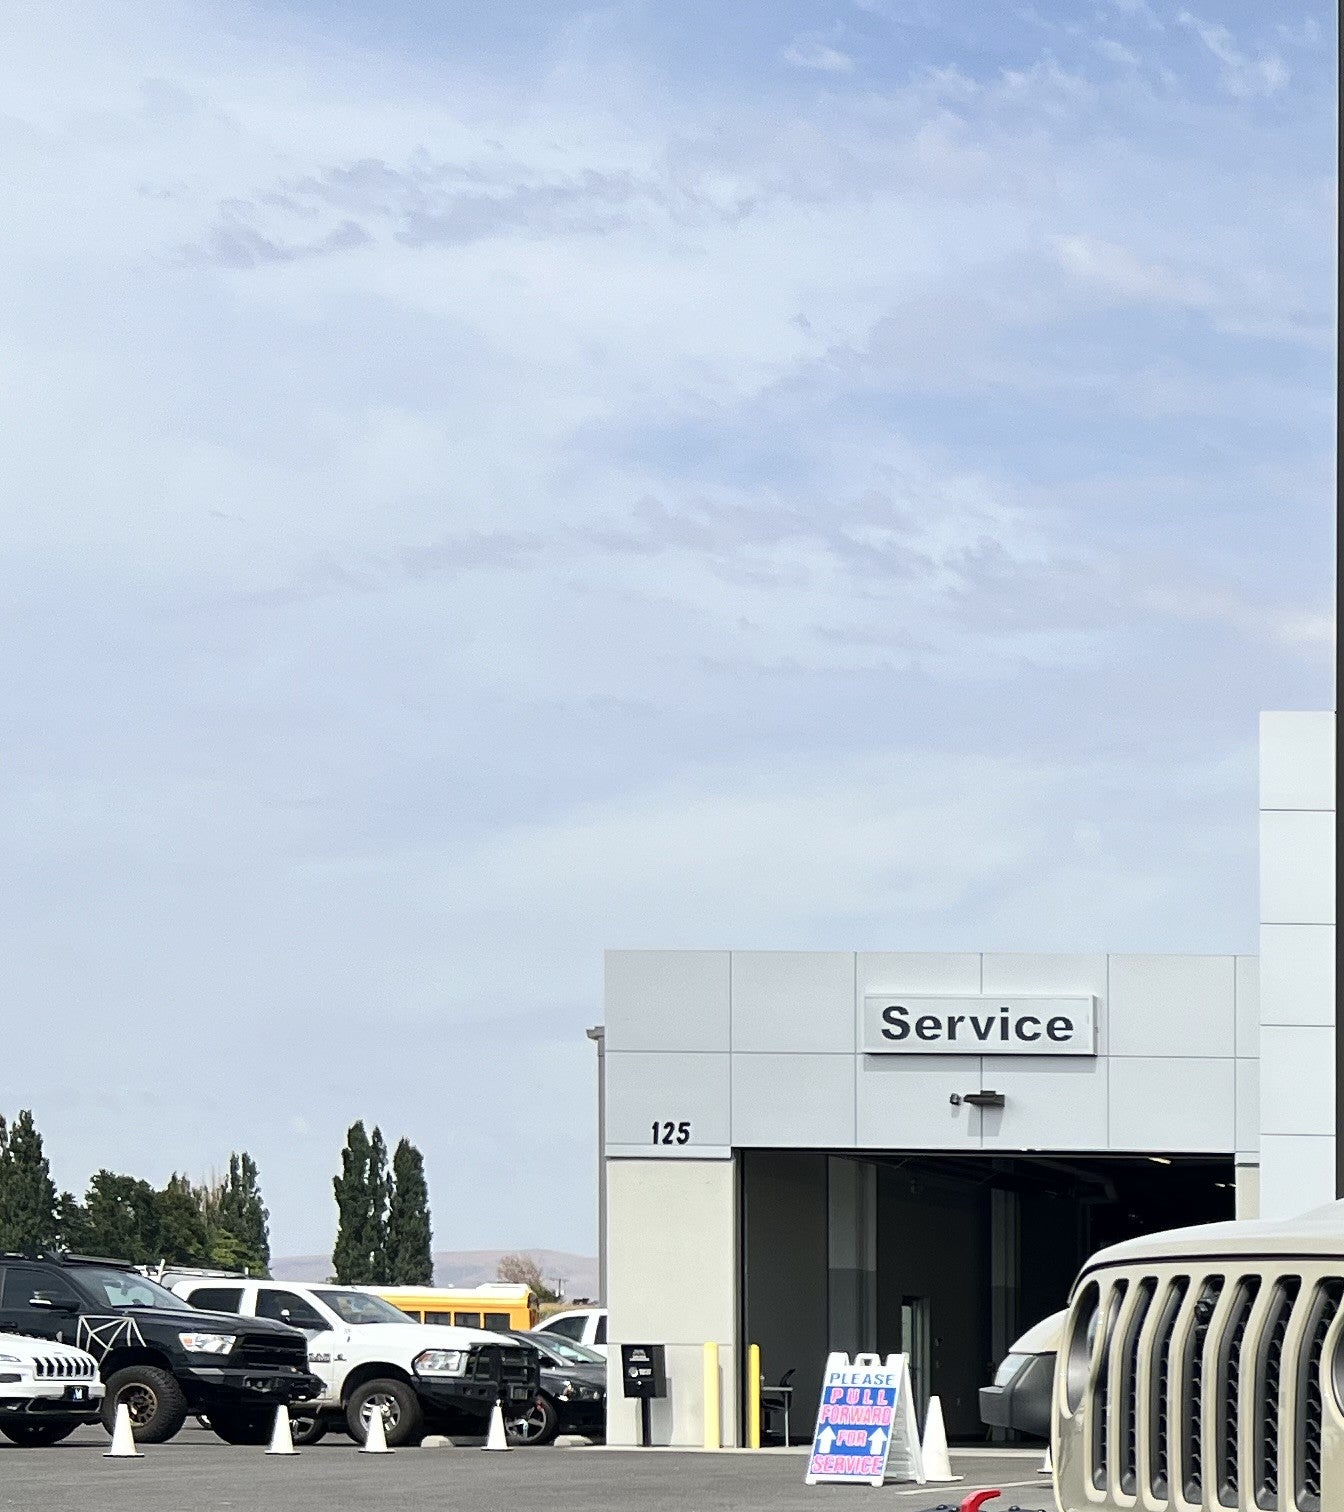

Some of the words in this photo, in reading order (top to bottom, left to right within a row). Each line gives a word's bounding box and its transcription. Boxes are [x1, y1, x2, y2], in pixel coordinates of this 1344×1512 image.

[880, 1005, 1074, 1042] Service
[651, 1121, 691, 1145] 125
[829, 1372, 897, 1386] PLEASE
[829, 1387, 889, 1406] PULL
[819, 1405, 895, 1426] FORWARD
[835, 1429, 868, 1447] FOR
[812, 1454, 883, 1474] SERVICE
